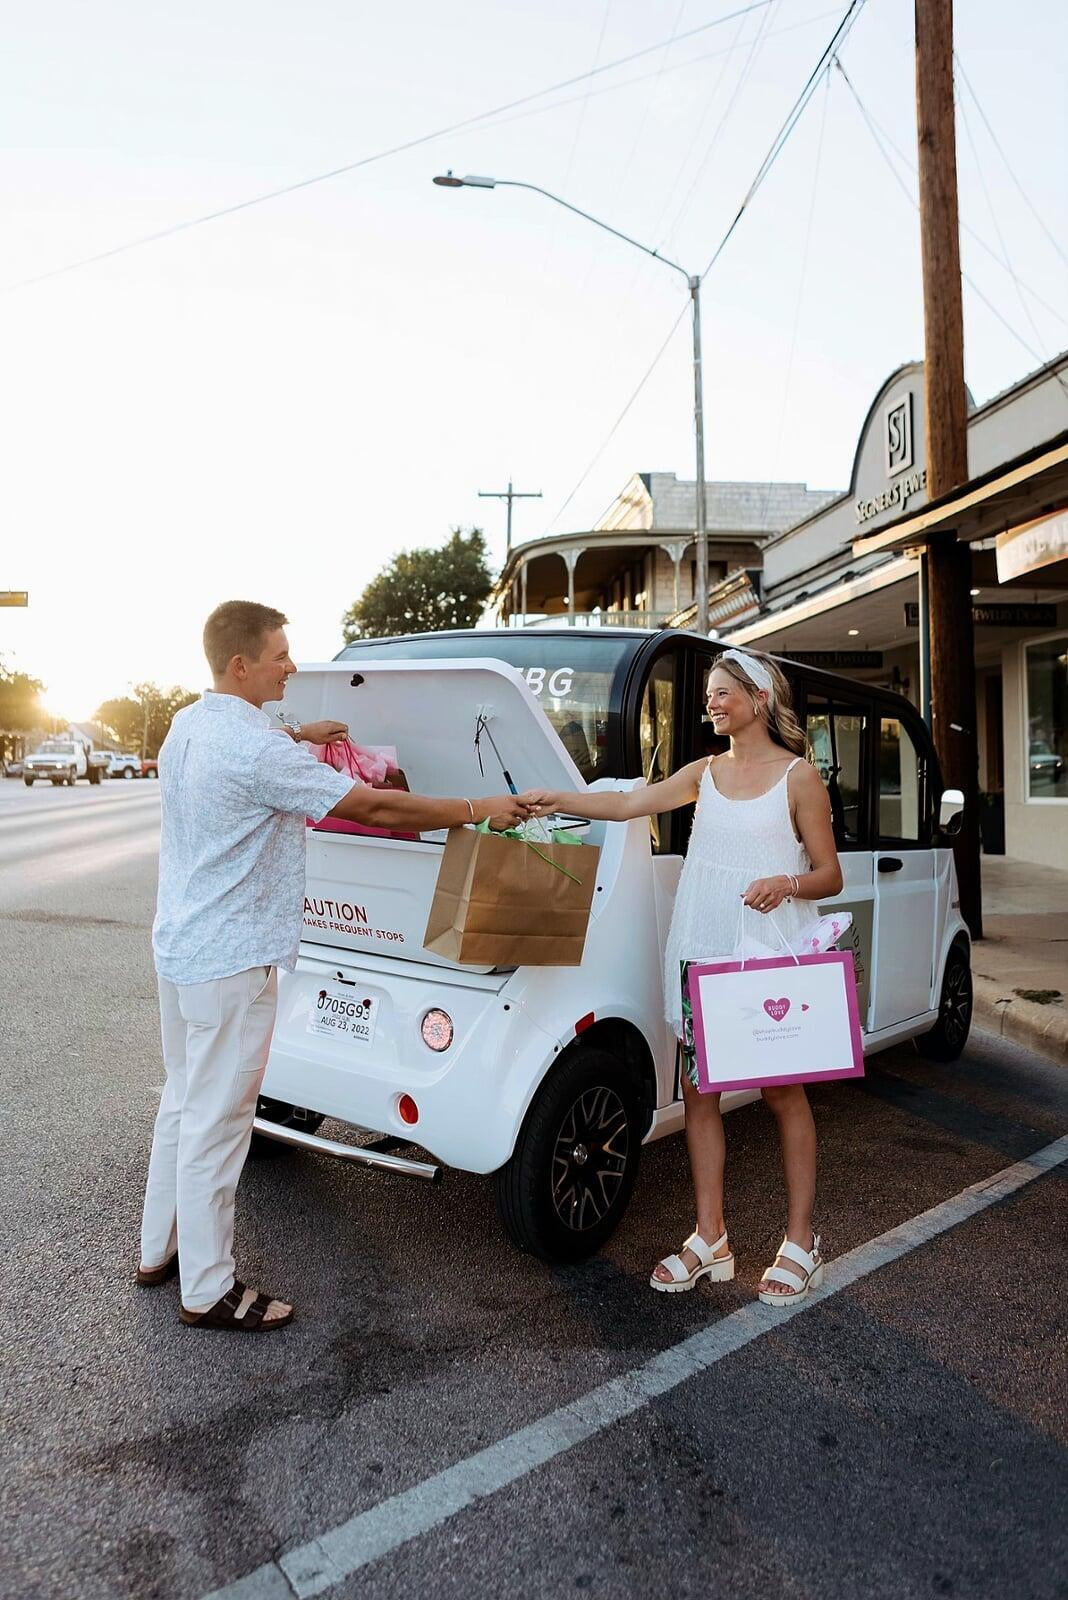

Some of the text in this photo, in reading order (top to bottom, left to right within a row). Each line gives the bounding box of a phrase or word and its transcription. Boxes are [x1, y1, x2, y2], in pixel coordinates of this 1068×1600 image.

[899, 470, 927, 511] JEWE
[513, 667, 575, 697] BG
[303, 897, 367, 923] AUTION
[330, 921, 373, 937] FREQUENT
[376, 929, 405, 943] STOPS
[321, 1016, 336, 1027] AUG
[338, 1020, 349, 1032] 23,
[351, 1023, 370, 1036] 2022
